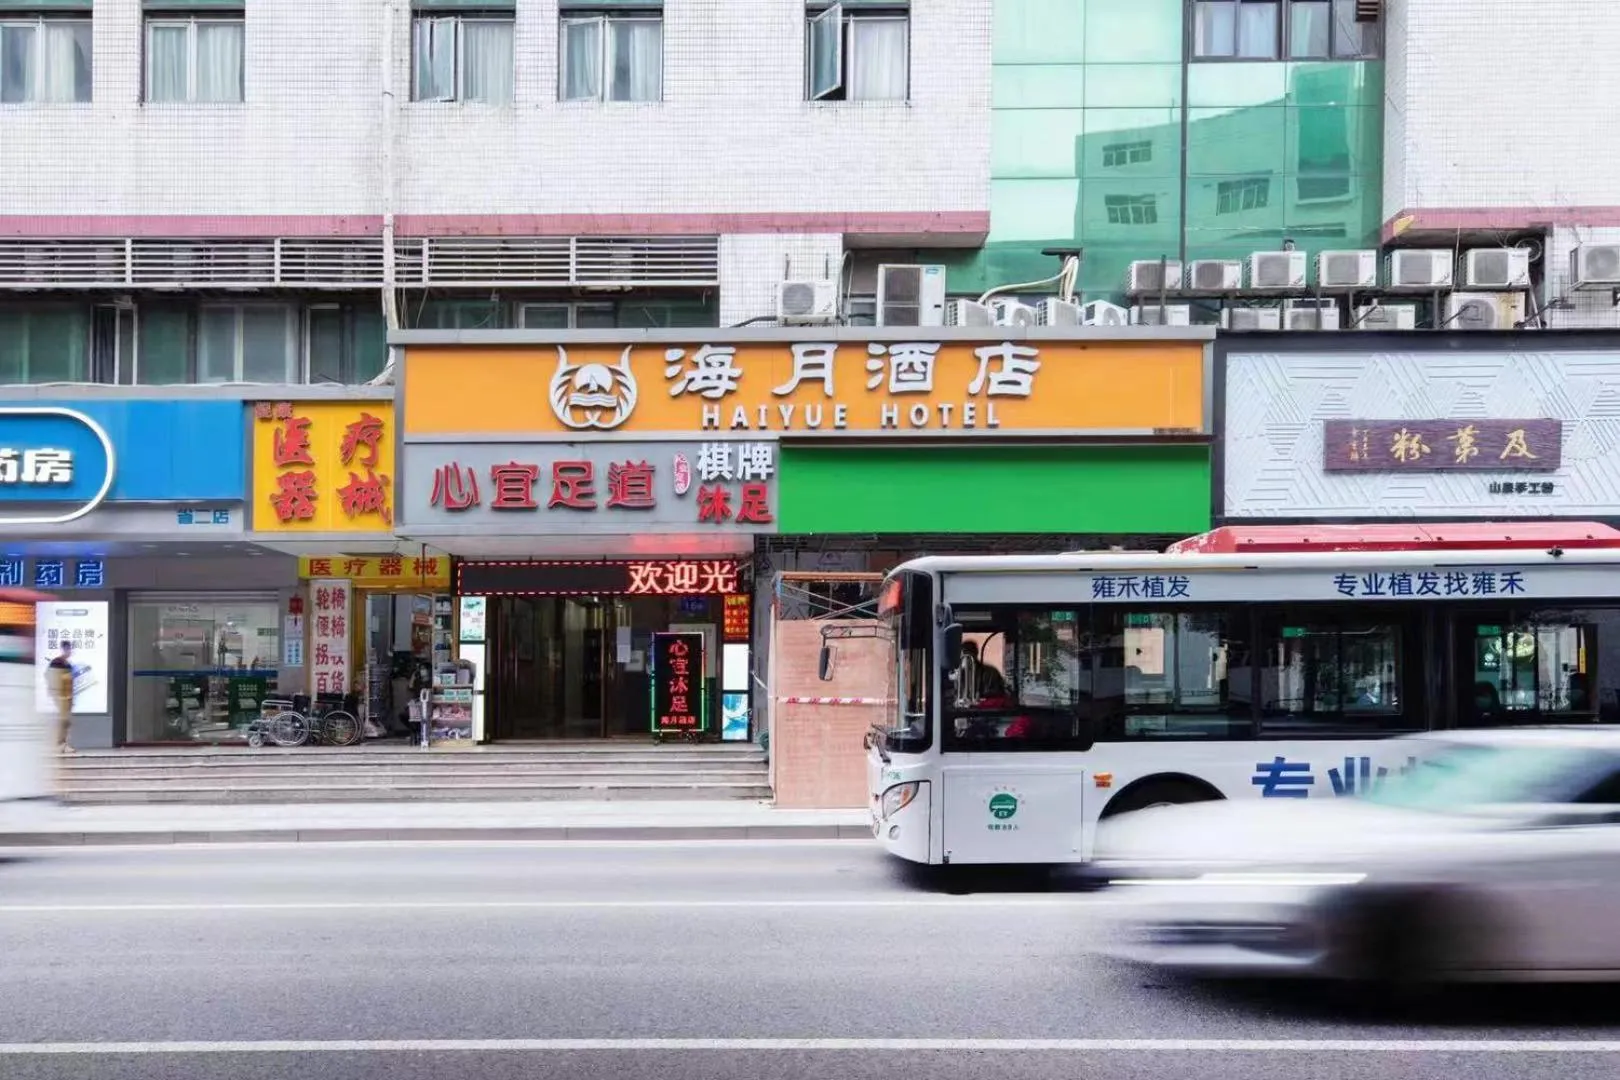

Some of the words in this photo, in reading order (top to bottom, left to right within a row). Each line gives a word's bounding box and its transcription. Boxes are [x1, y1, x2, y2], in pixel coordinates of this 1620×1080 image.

[665, 341, 1042, 399] 海月酒店
[701, 403, 848, 429] HAIYUE
[880, 402, 1001, 429] HOTEL
[696, 441, 775, 482] 棋牌
[430, 460, 657, 512] 心宜足道
[695, 482, 774, 525] 沐足
[308, 557, 439, 577] 医疗器械
[627, 561, 738, 594] 欢迎光
[1091, 575, 1191, 600] 雍禾植发
[1332, 571, 1527, 597] 专业植发找雍禾
